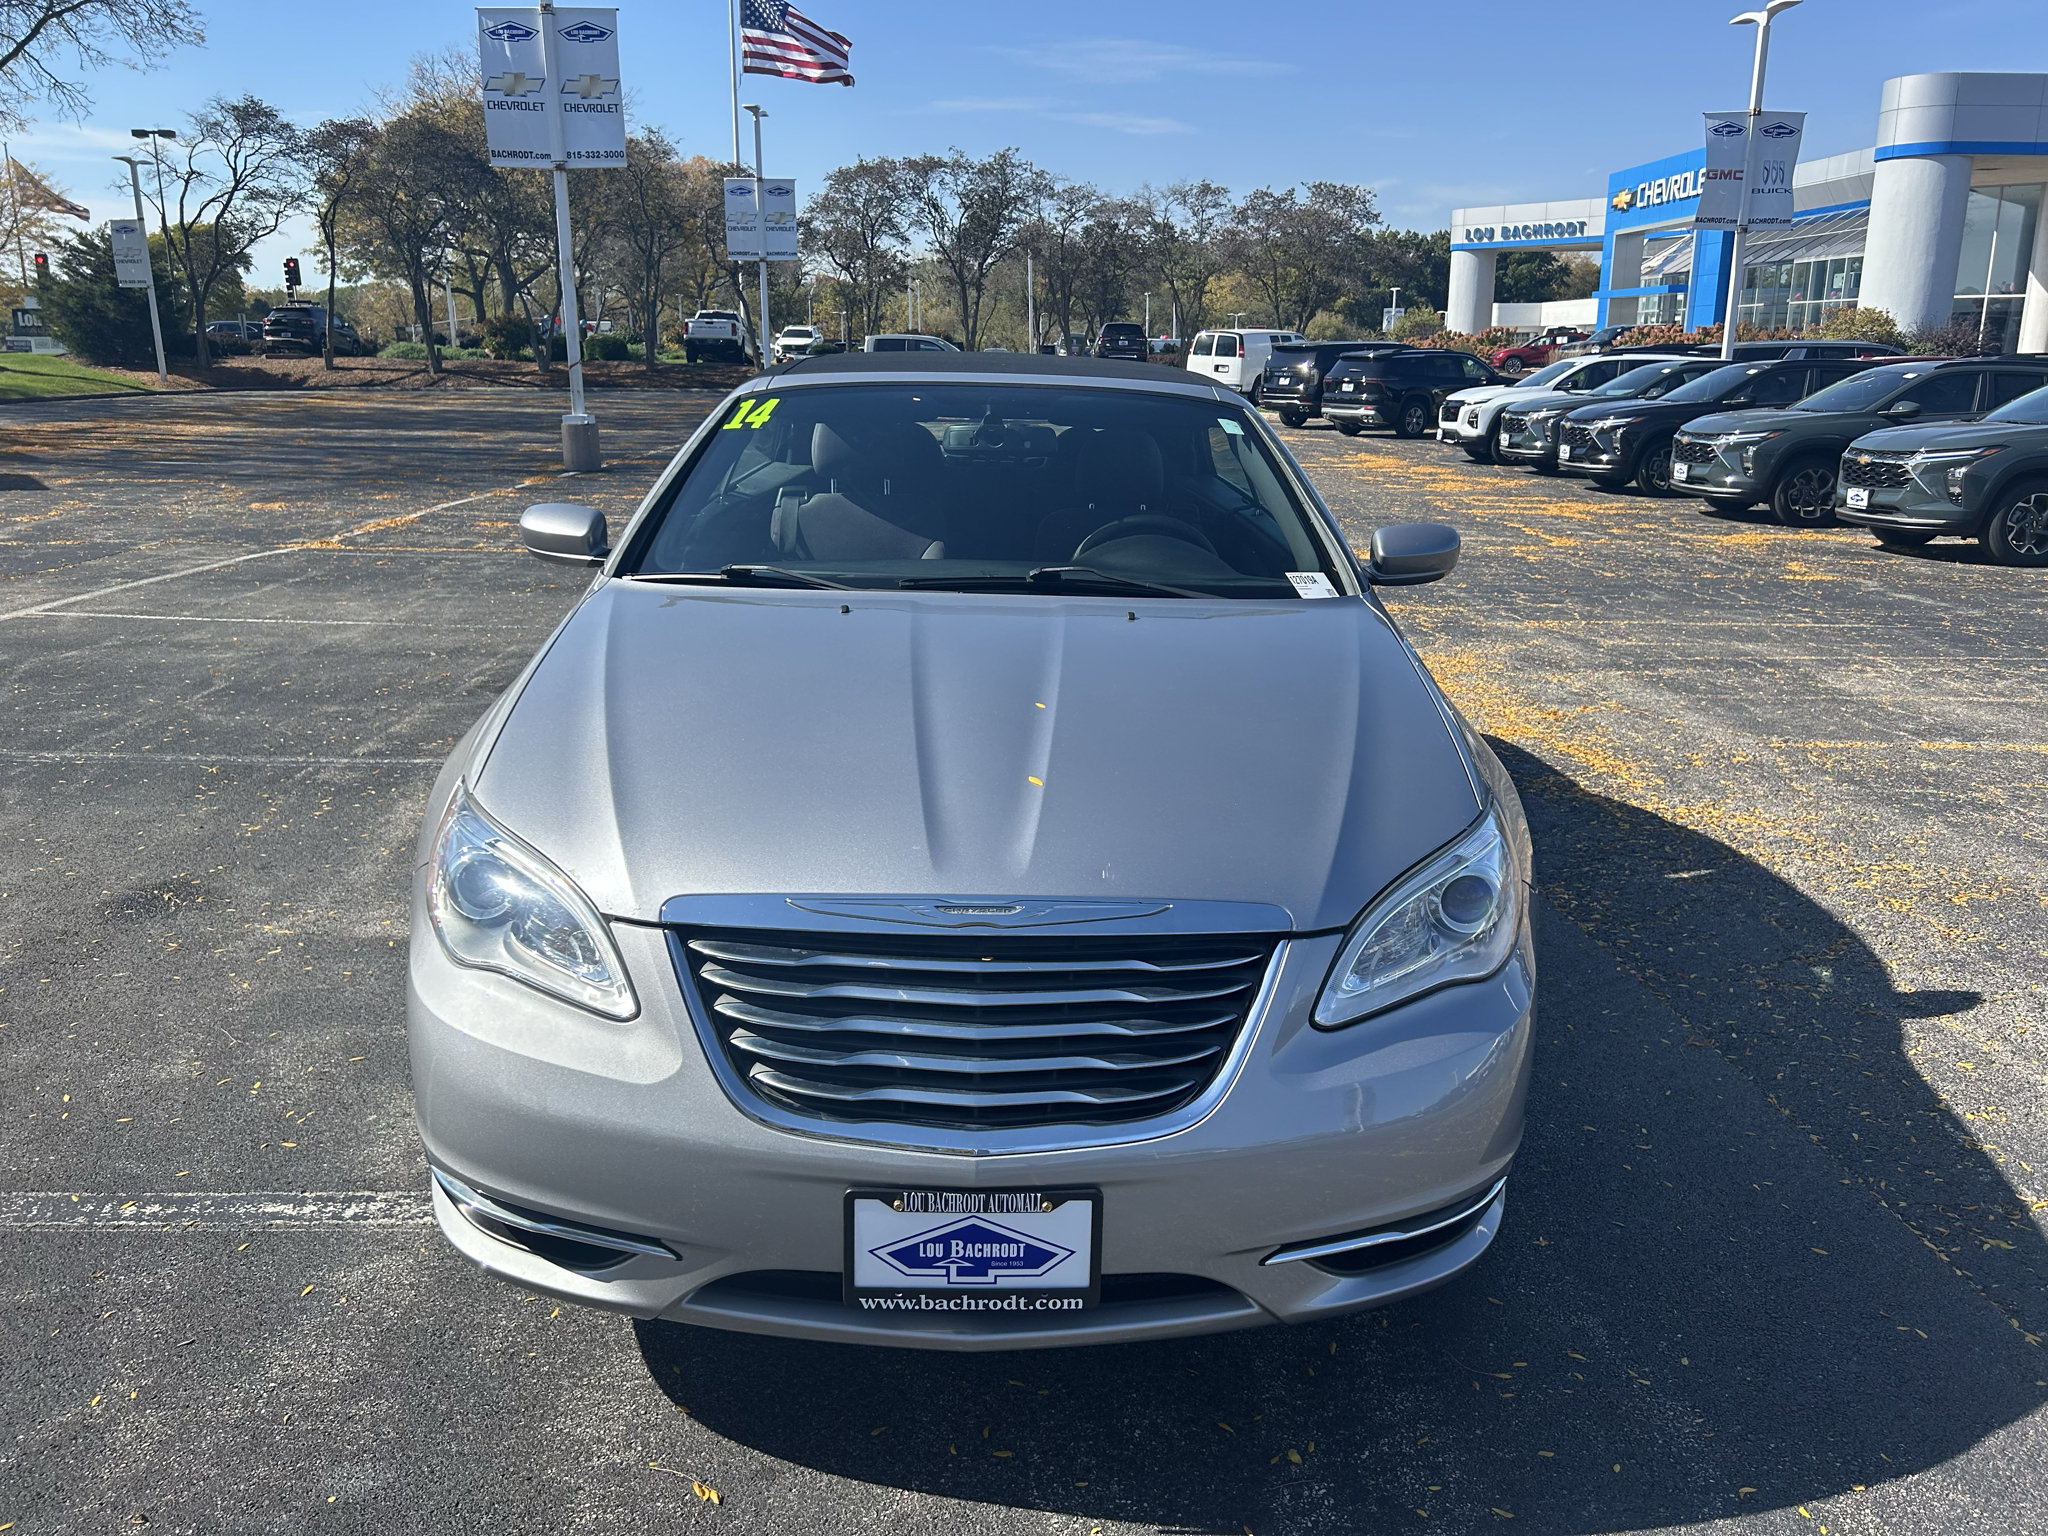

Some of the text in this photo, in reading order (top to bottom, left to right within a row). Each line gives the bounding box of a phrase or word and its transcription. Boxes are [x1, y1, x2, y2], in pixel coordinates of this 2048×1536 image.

[487, 100, 545, 112] CHEVROLET
[564, 103, 619, 113] CHEVROLET
[491, 150, 551, 160] BACHRODT.com
[566, 150, 625, 159] 815-332-3000
[1706, 169, 1744, 181] GMC
[1636, 167, 1705, 208] CHEVROLE
[1465, 221, 1588, 242] LOU BACHRODT
[723, 398, 780, 429] 14
[903, 1192, 1043, 1213] LOU BACHRODT AUTOMALL
[919, 1243, 944, 1258] LOU
[859, 1295, 1084, 1311] www.bachrodt.com
